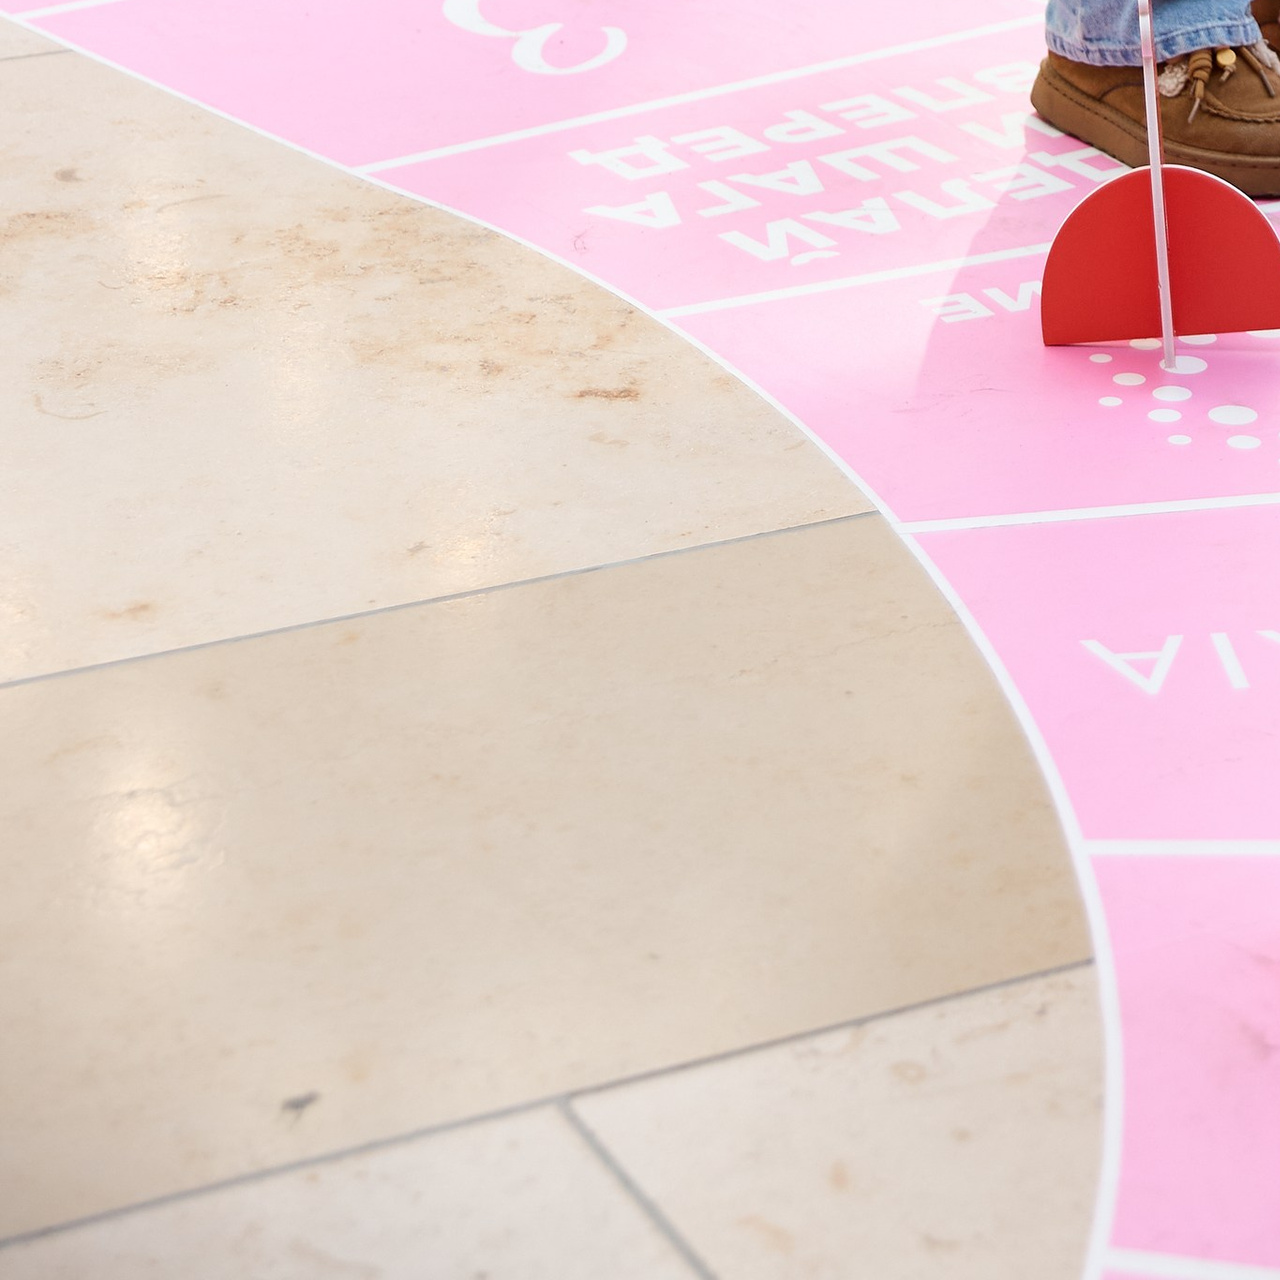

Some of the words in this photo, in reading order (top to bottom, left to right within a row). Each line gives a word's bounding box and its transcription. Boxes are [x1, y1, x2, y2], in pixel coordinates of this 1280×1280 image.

[568, 61, 1037, 181] ВПЕРЕД
[582, 137, 958, 229] ШАГА
[718, 147, 1126, 266] ДЕЛАЙ
